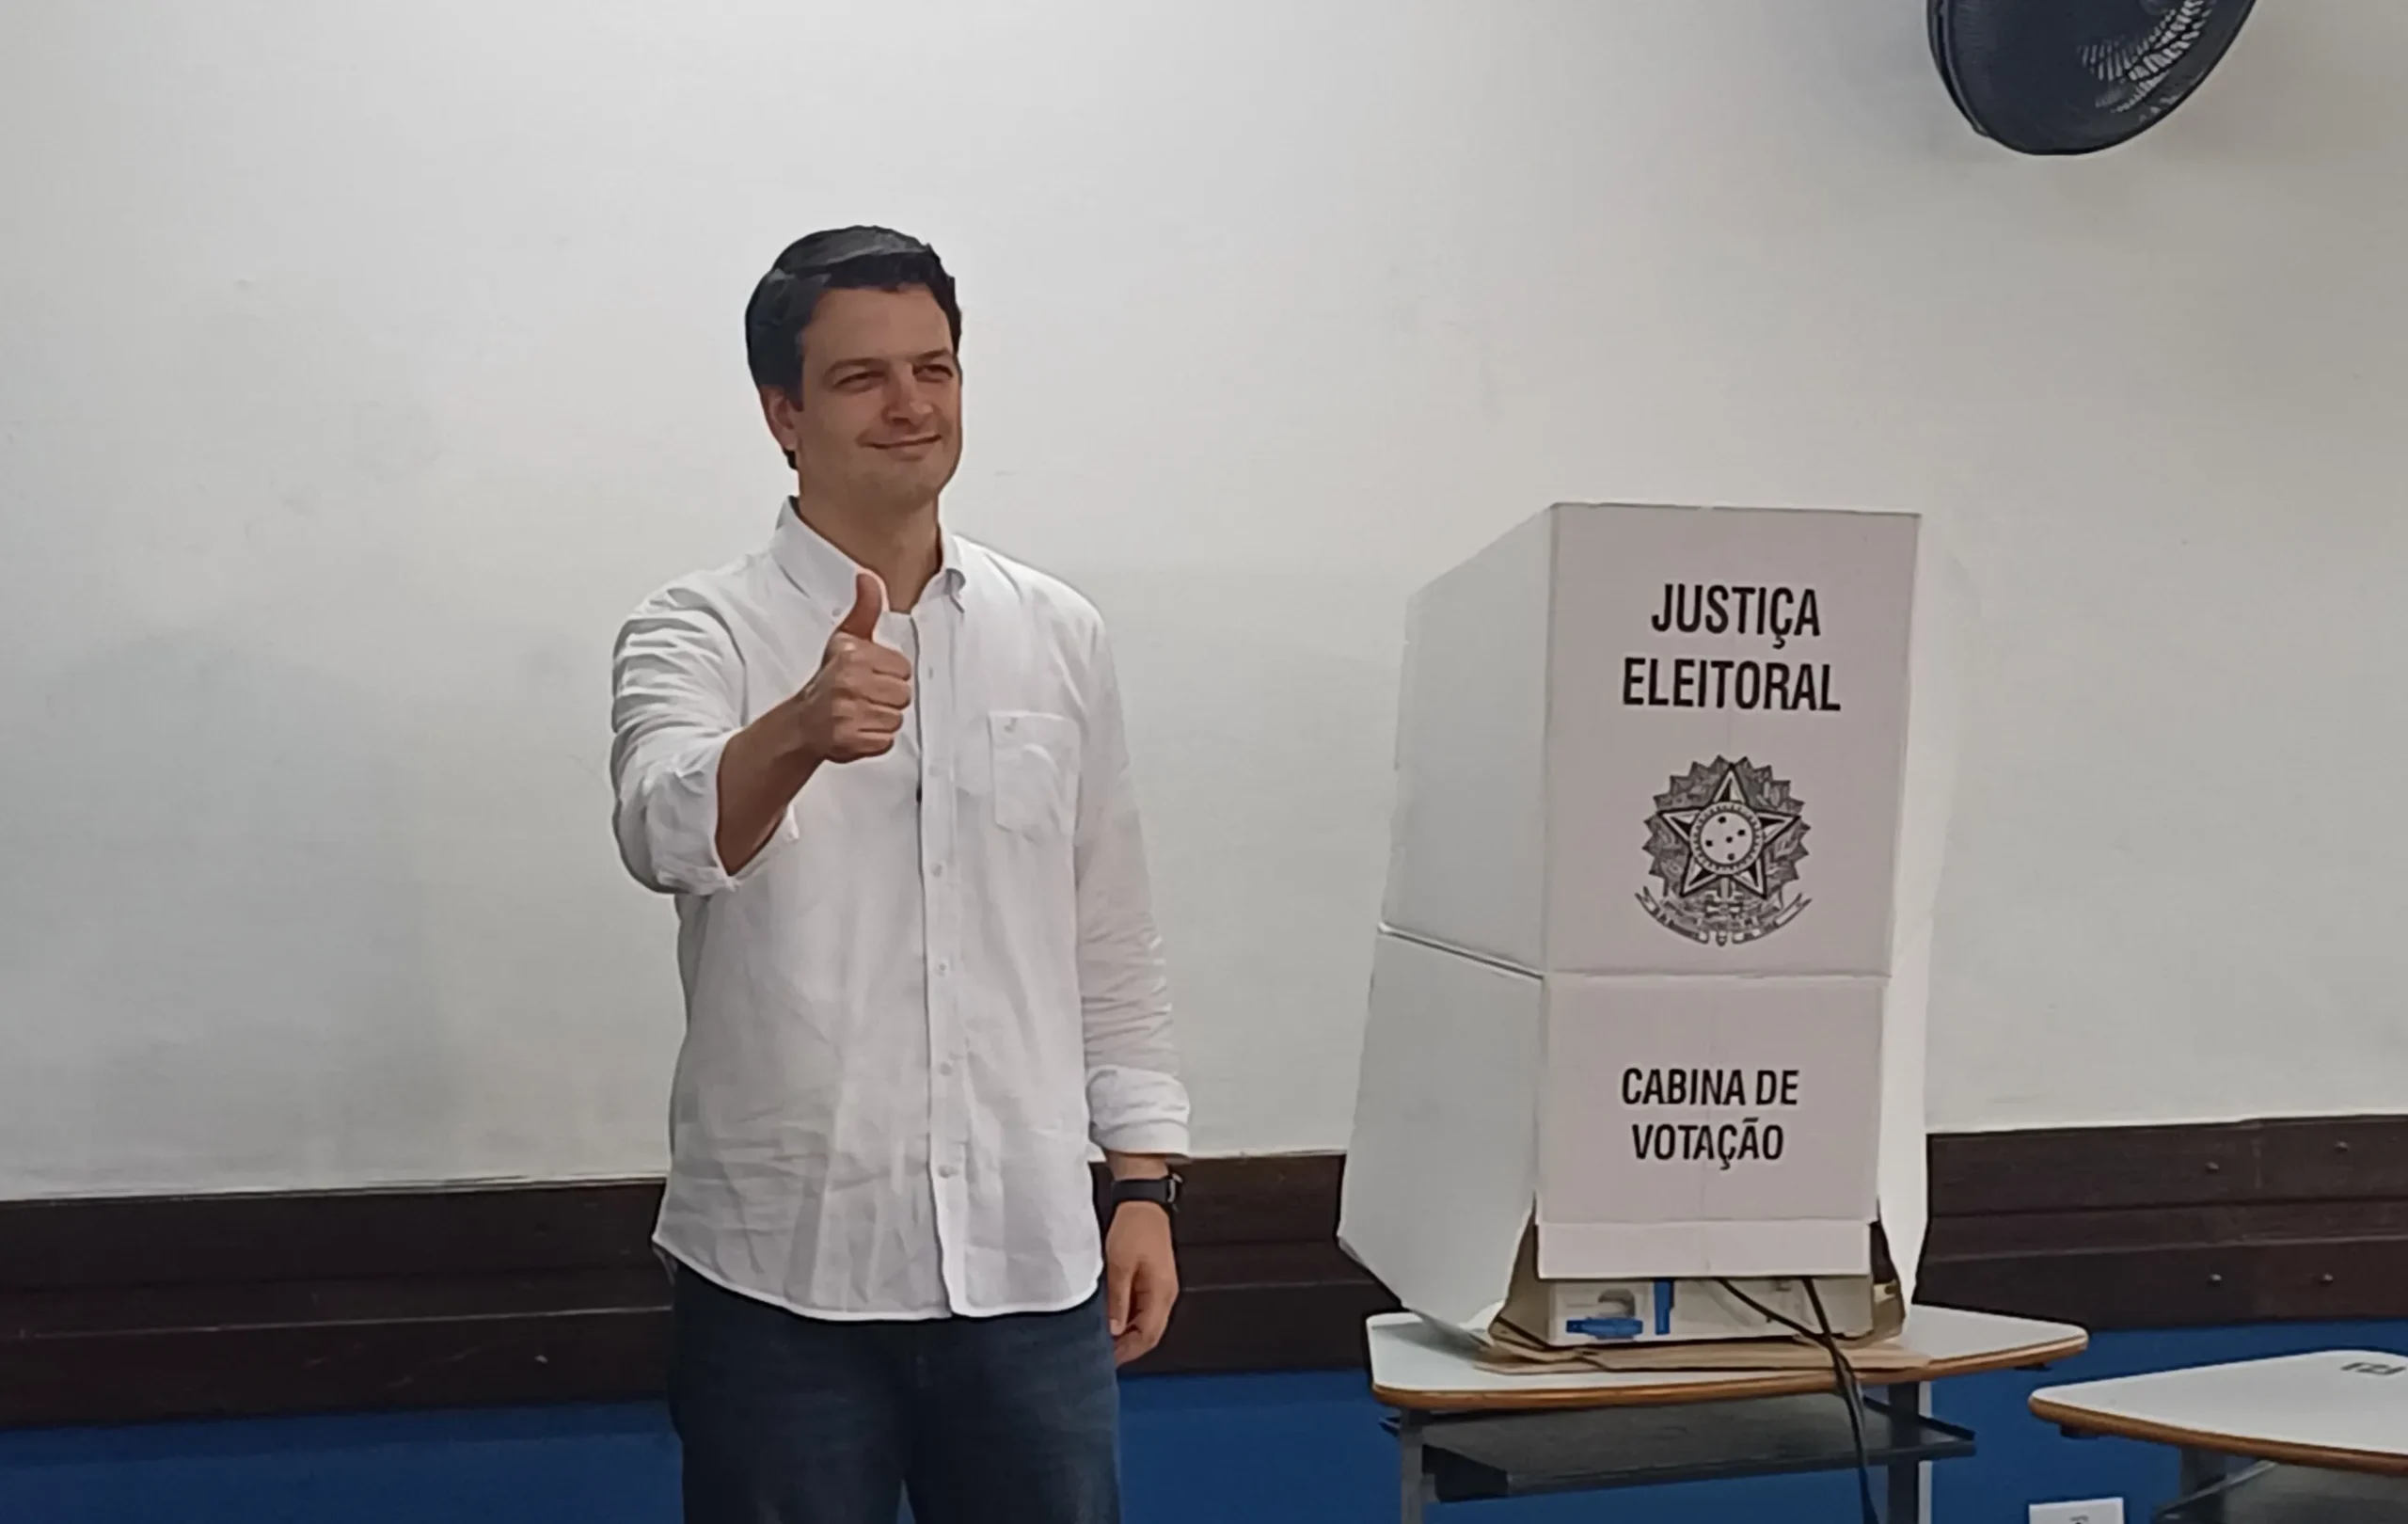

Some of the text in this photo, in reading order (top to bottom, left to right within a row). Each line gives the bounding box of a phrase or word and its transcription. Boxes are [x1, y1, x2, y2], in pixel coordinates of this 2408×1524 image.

[1651, 583, 1821, 649] JUSTIÇA
[1623, 657, 1842, 711] ELEITORAL
[1622, 1068, 1799, 1106] CABINA DE
[1632, 1117, 1784, 1170] VOTAÇÃO
